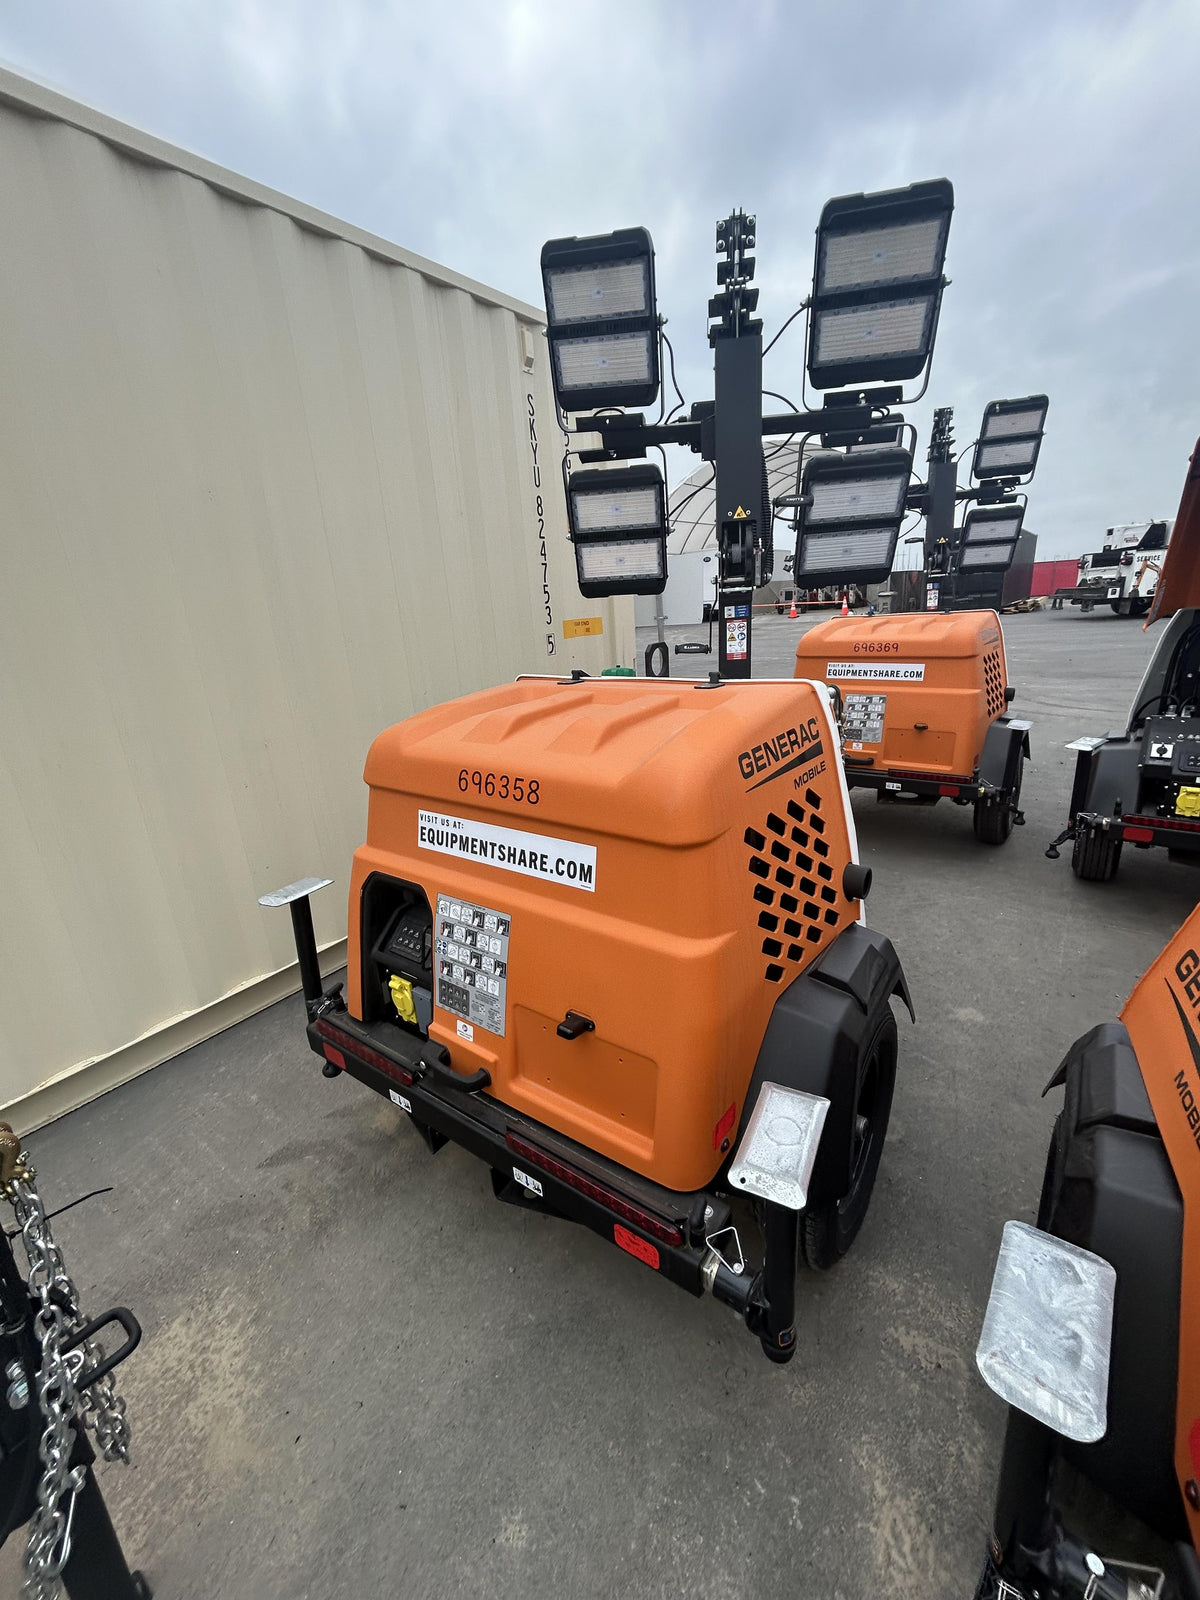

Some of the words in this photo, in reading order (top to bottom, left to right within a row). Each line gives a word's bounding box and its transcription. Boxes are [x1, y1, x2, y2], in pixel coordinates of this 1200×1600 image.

[527, 393, 541, 488] SKYU
[536, 495, 553, 625] 824753
[547, 636, 555, 654] 5
[853, 642, 899, 653] 696369
[827, 668, 923, 679] EQUIPMENTSHARE.COM
[738, 717, 820, 780] GENERAC
[458, 768, 541, 805] 696358
[793, 760, 827, 790] MOBILE
[419, 813, 439, 824] VISIT
[441, 817, 450, 827] US
[452, 821, 464, 830] AT:
[419, 825, 593, 884] EQUIPMENTSHARE.COM
